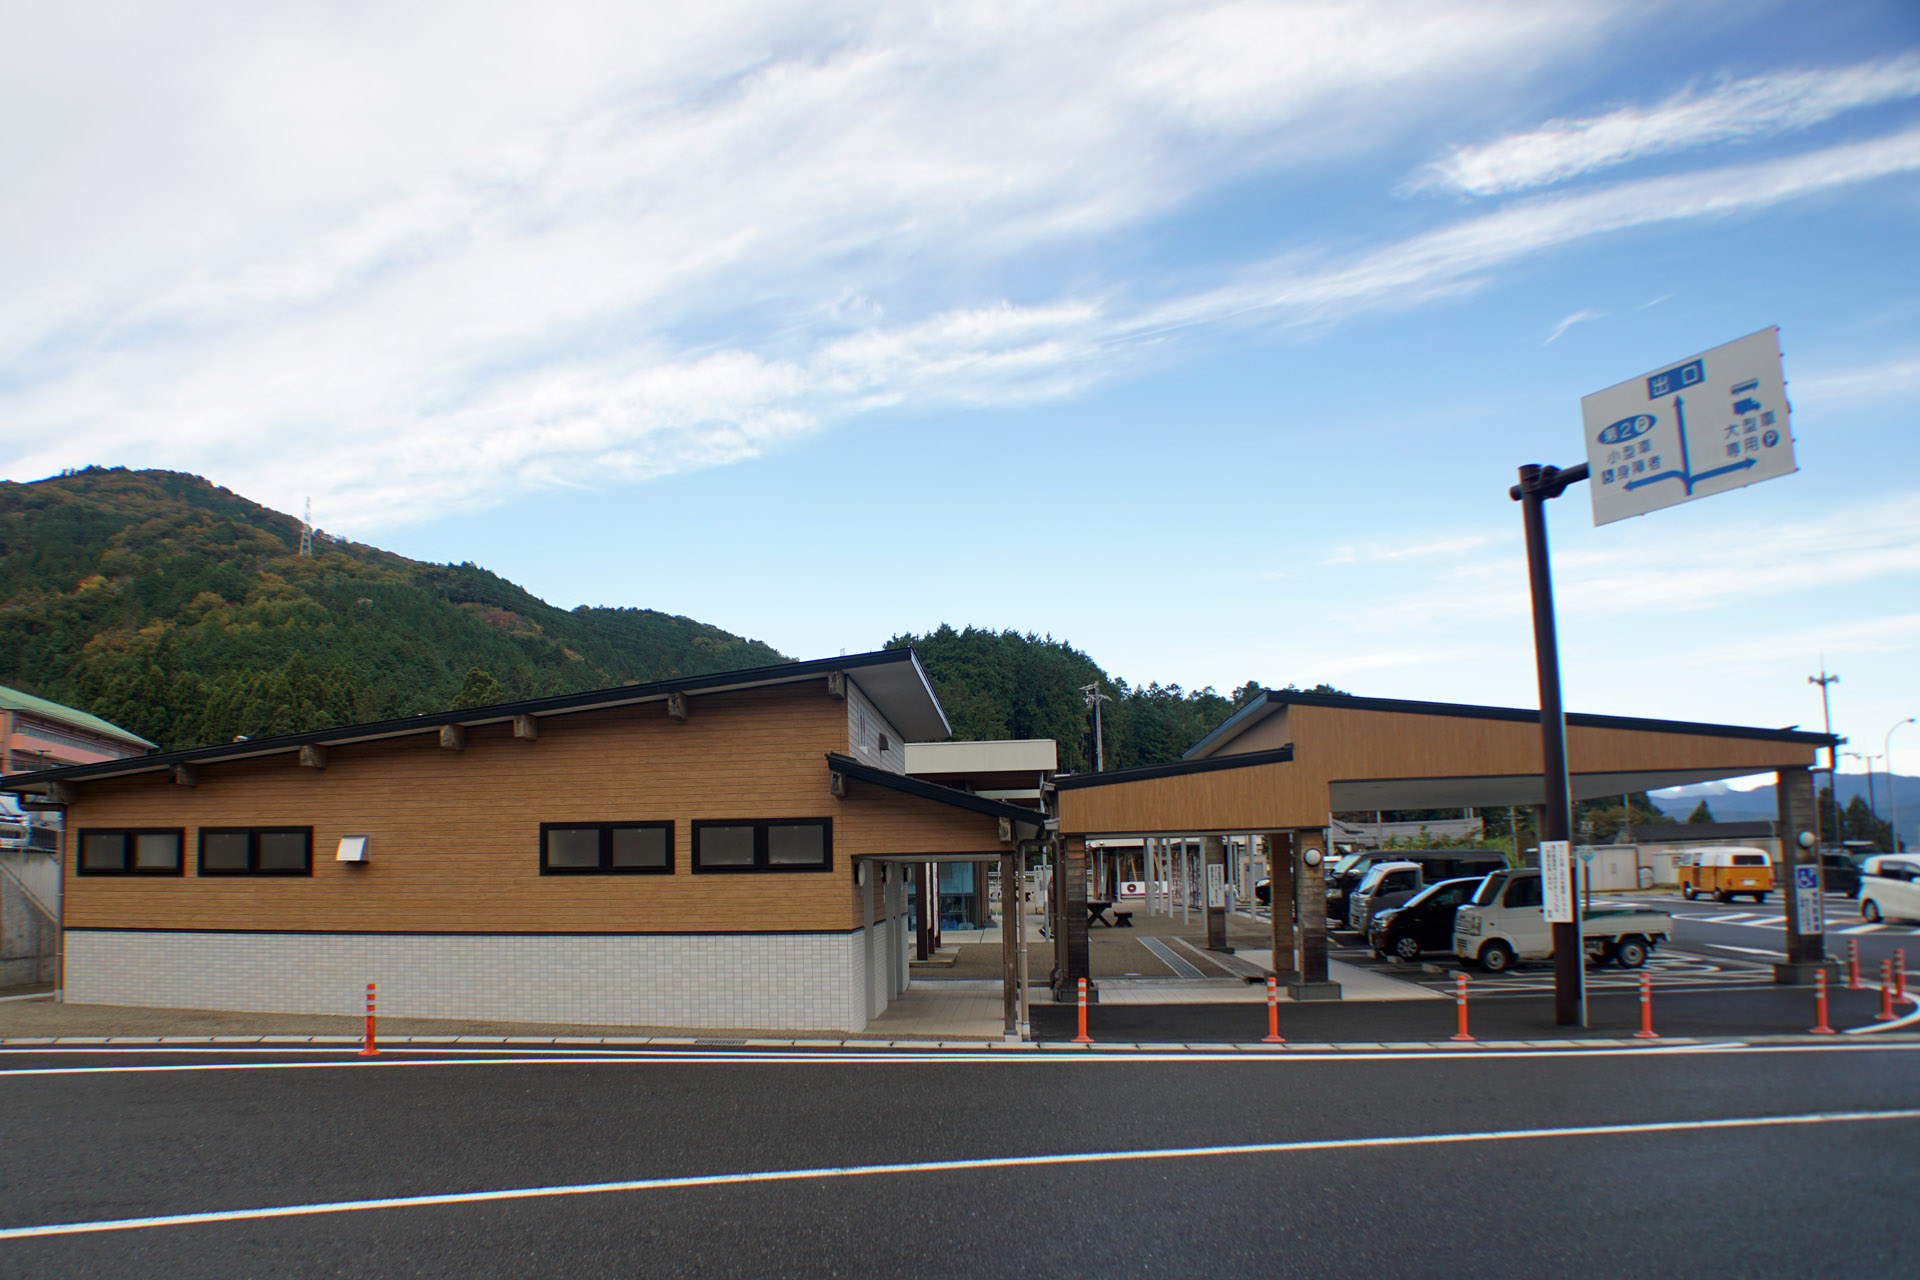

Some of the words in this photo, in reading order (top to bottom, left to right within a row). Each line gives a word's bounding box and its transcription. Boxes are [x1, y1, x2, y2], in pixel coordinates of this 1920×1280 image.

[1651, 364, 1700, 396] 出口
[1723, 410, 1776, 440] 大型車
[1607, 439, 1652, 465] 小型車
